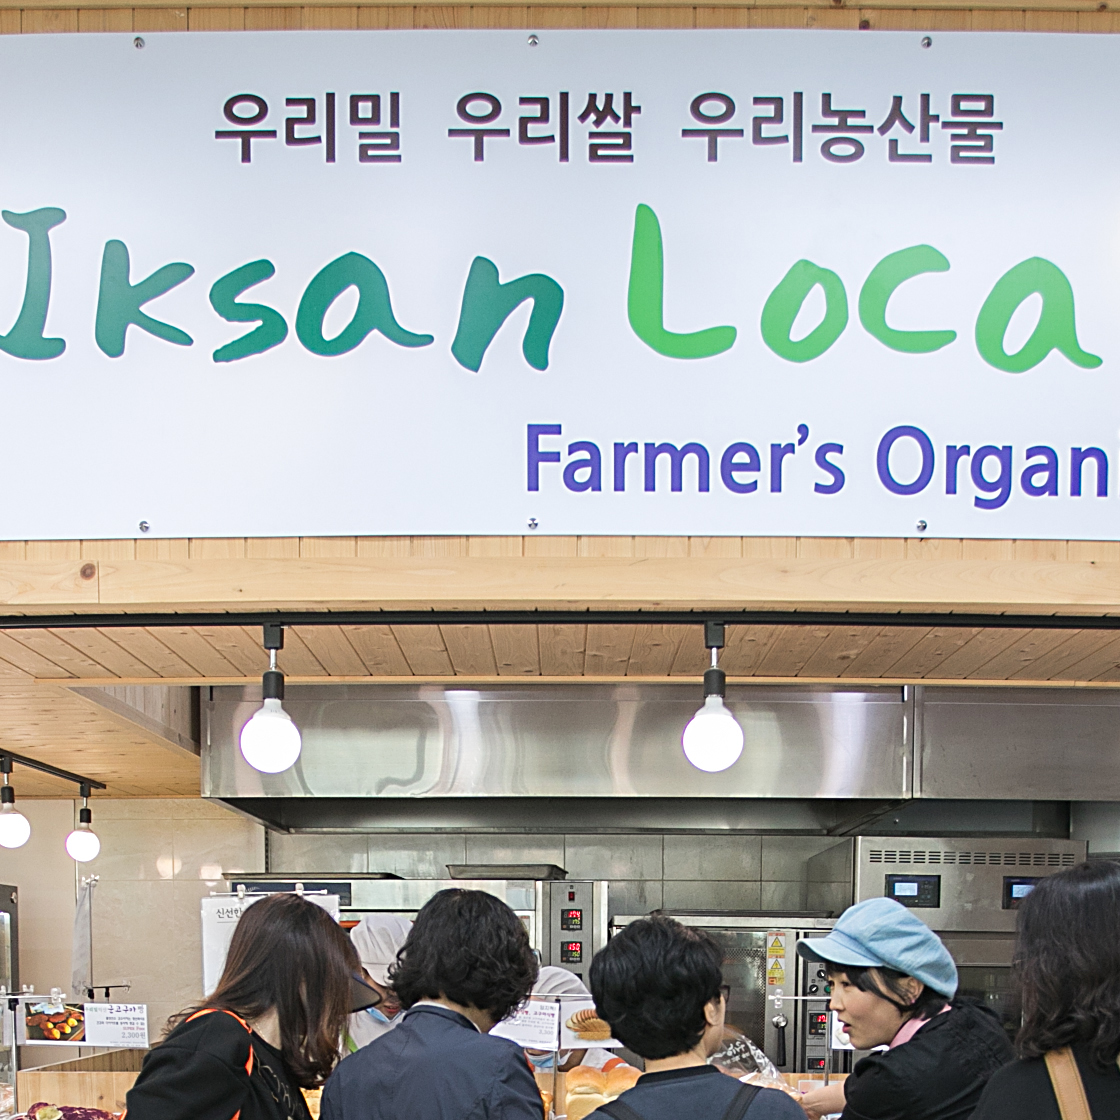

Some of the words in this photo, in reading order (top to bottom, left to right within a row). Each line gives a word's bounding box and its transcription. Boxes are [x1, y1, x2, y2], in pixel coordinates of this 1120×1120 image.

[215, 91, 402, 163] 우리밀
[448, 91, 641, 163] 우리쌀
[682, 91, 1004, 164] 우리농산물
[0, 206, 565, 373] Iksan
[527, 423, 845, 496] Farmer's
